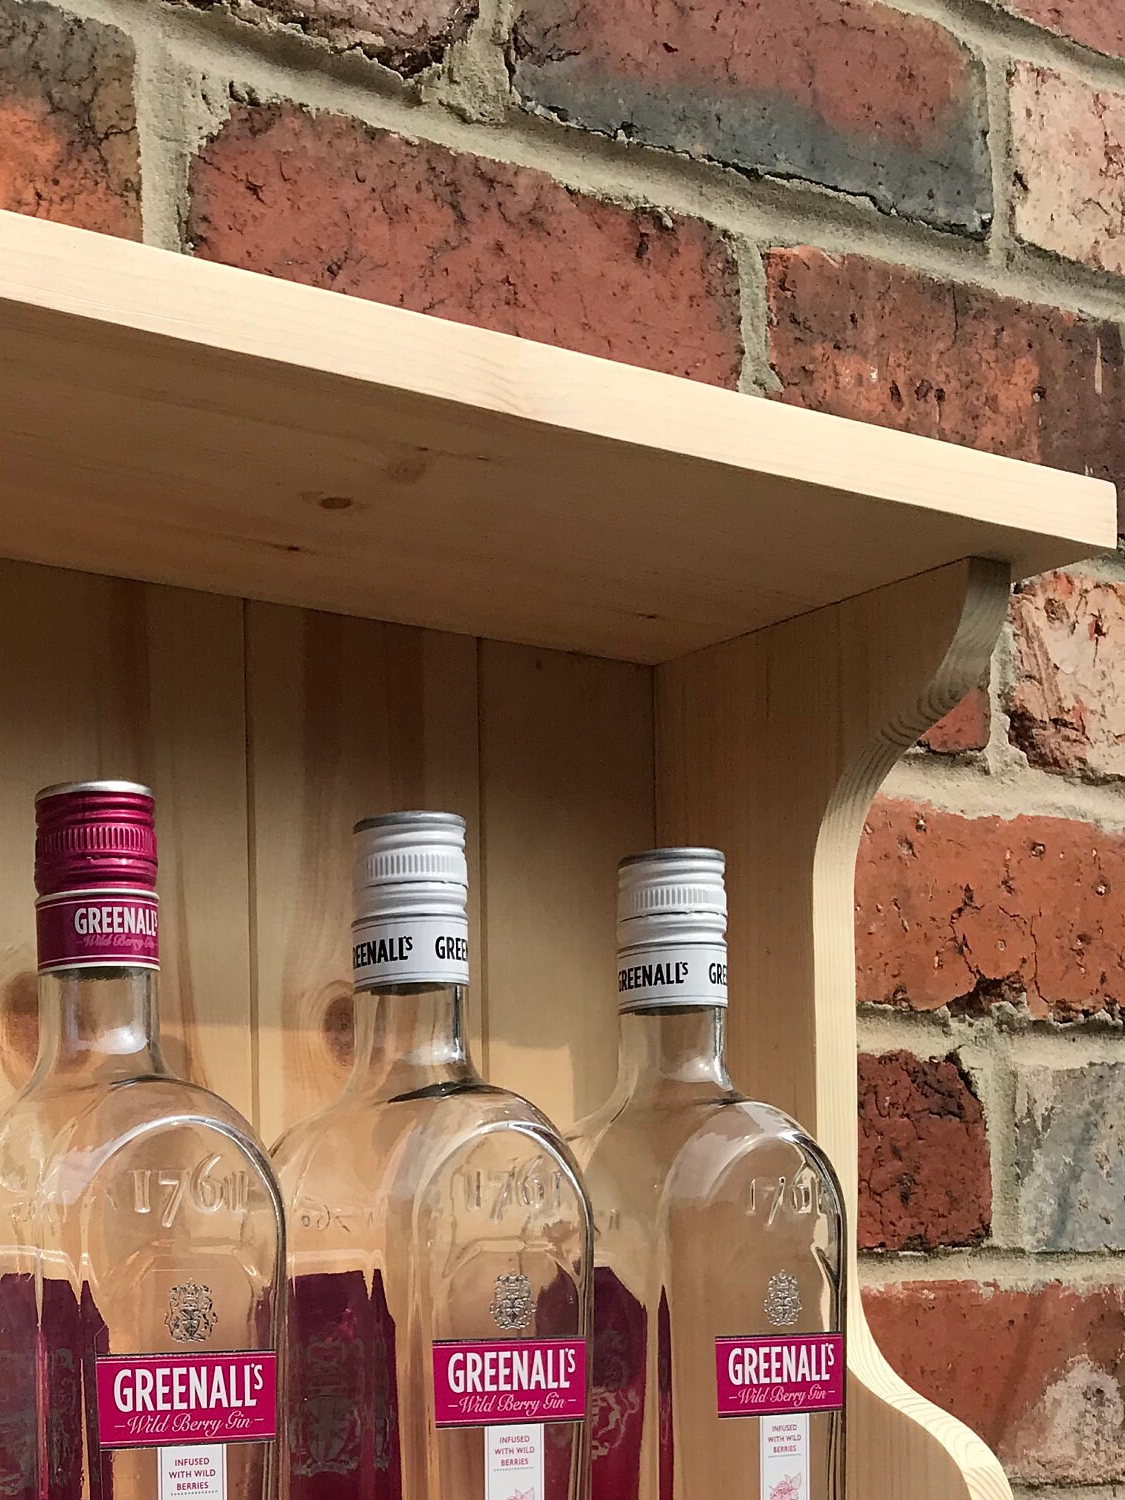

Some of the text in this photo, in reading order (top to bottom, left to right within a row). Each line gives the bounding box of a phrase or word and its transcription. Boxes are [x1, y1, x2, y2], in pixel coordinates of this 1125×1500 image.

[127, 1153, 249, 1228] 1761
[728, 1342, 835, 1386] GREENALL'S
[447, 1348, 576, 1394] GREENALL'S
[113, 1363, 264, 1413] GREENALL'S
[737, 1383, 826, 1407] Wild Berry Gin
[459, 1391, 565, 1416] Wild Berry Gin
[126, 1410, 252, 1437] Wild Berry Gin
[771, 1424, 798, 1432] INFUSED
[499, 1435, 530, 1444] INFUSED
[494, 1446, 535, 1456] WITH WILD
[773, 1445, 797, 1453] BERRIES
[174, 1457, 210, 1467] INFUSED
[500, 1457, 529, 1467] BERRIES
[168, 1469, 216, 1479] WITH WILD
[176, 1481, 209, 1491] BERRIES
